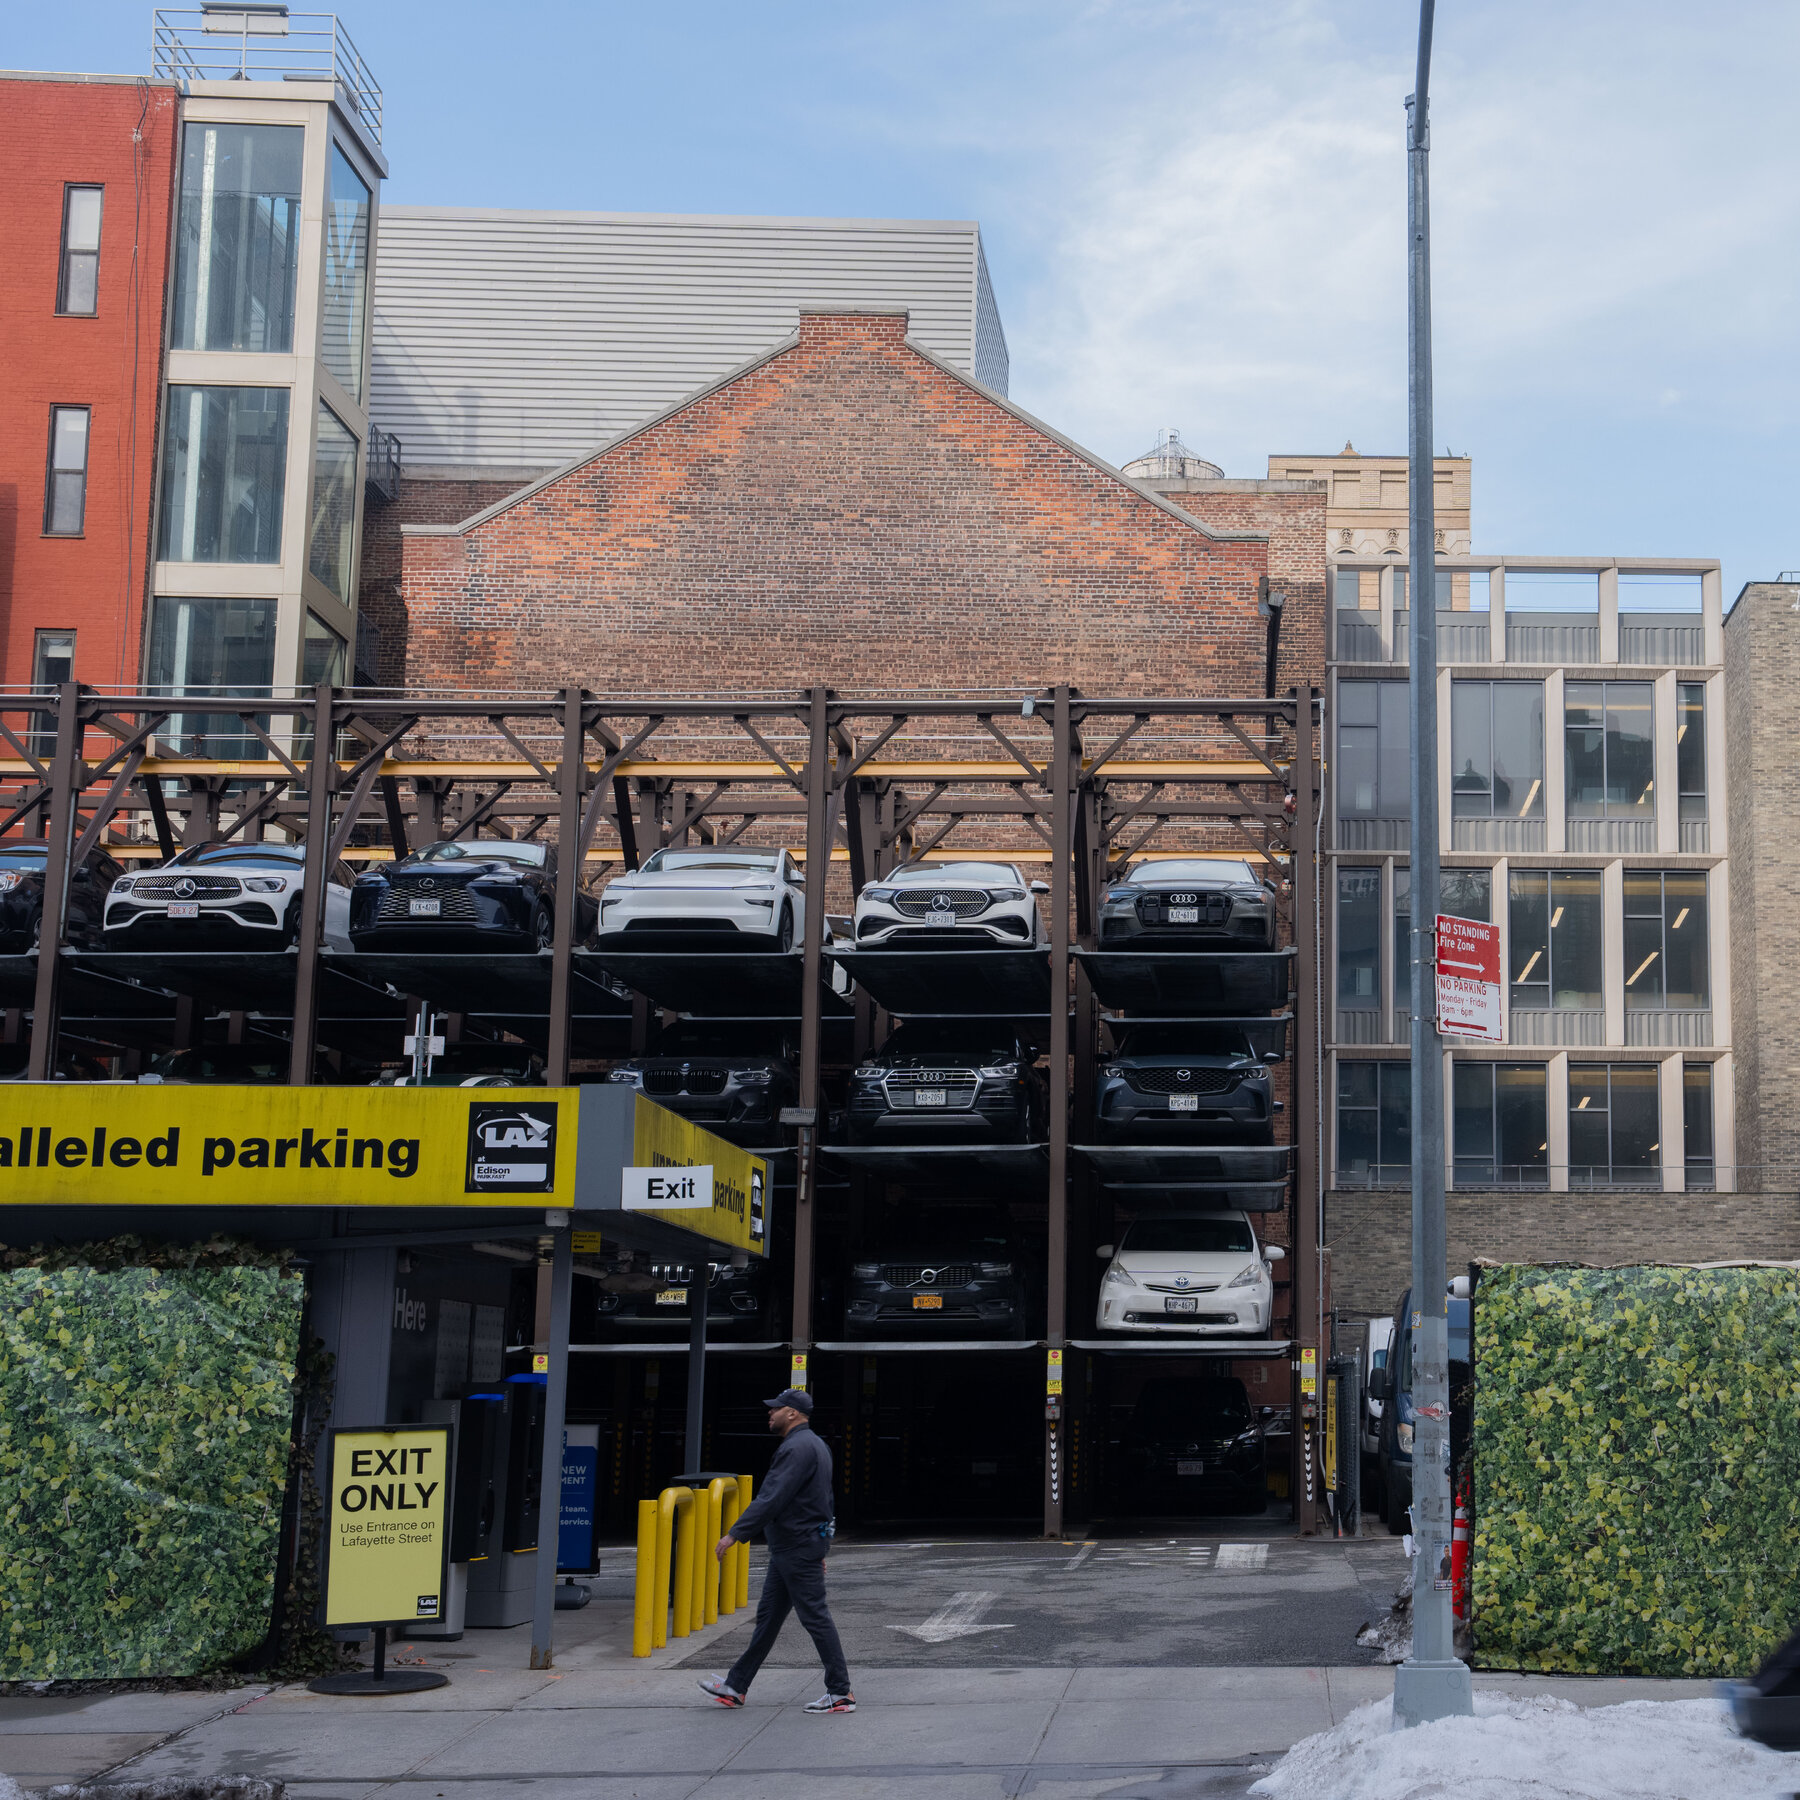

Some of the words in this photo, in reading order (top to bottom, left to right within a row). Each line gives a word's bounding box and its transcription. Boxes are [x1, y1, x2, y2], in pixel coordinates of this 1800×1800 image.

[1440, 921, 1451, 933] NO
[1453, 924, 1490, 941] STANDING
[1440, 936, 1455, 947] Fire
[1457, 939, 1476, 953] Zone
[1440, 979, 1452, 990] NO
[1454, 981, 1487, 996] PARKING
[1440, 993, 1465, 1005] Monday
[1470, 997, 1487, 1009] Friday
[1441, 1004, 1456, 1014] 8am
[1461, 1007, 1474, 1018] 6pm
[485, 1127, 548, 1148] LAZ
[202, 1128, 421, 1178] parking
[477, 1166, 511, 1174] Edison
[648, 1178, 695, 1199] Exit
[714, 1177, 746, 1224] parking
[394, 1287, 427, 1332] Here
[351, 1448, 432, 1477] EXIT
[561, 1465, 588, 1475] NEW
[340, 1482, 439, 1512] ONLY
[564, 1505, 588, 1513] team.
[340, 1523, 364, 1534] Use
[367, 1520, 418, 1532] Entrance
[421, 1520, 436, 1530] on
[560, 1517, 592, 1526] service.
[342, 1534, 396, 1548] Lafayette
[398, 1532, 433, 1544] Street
